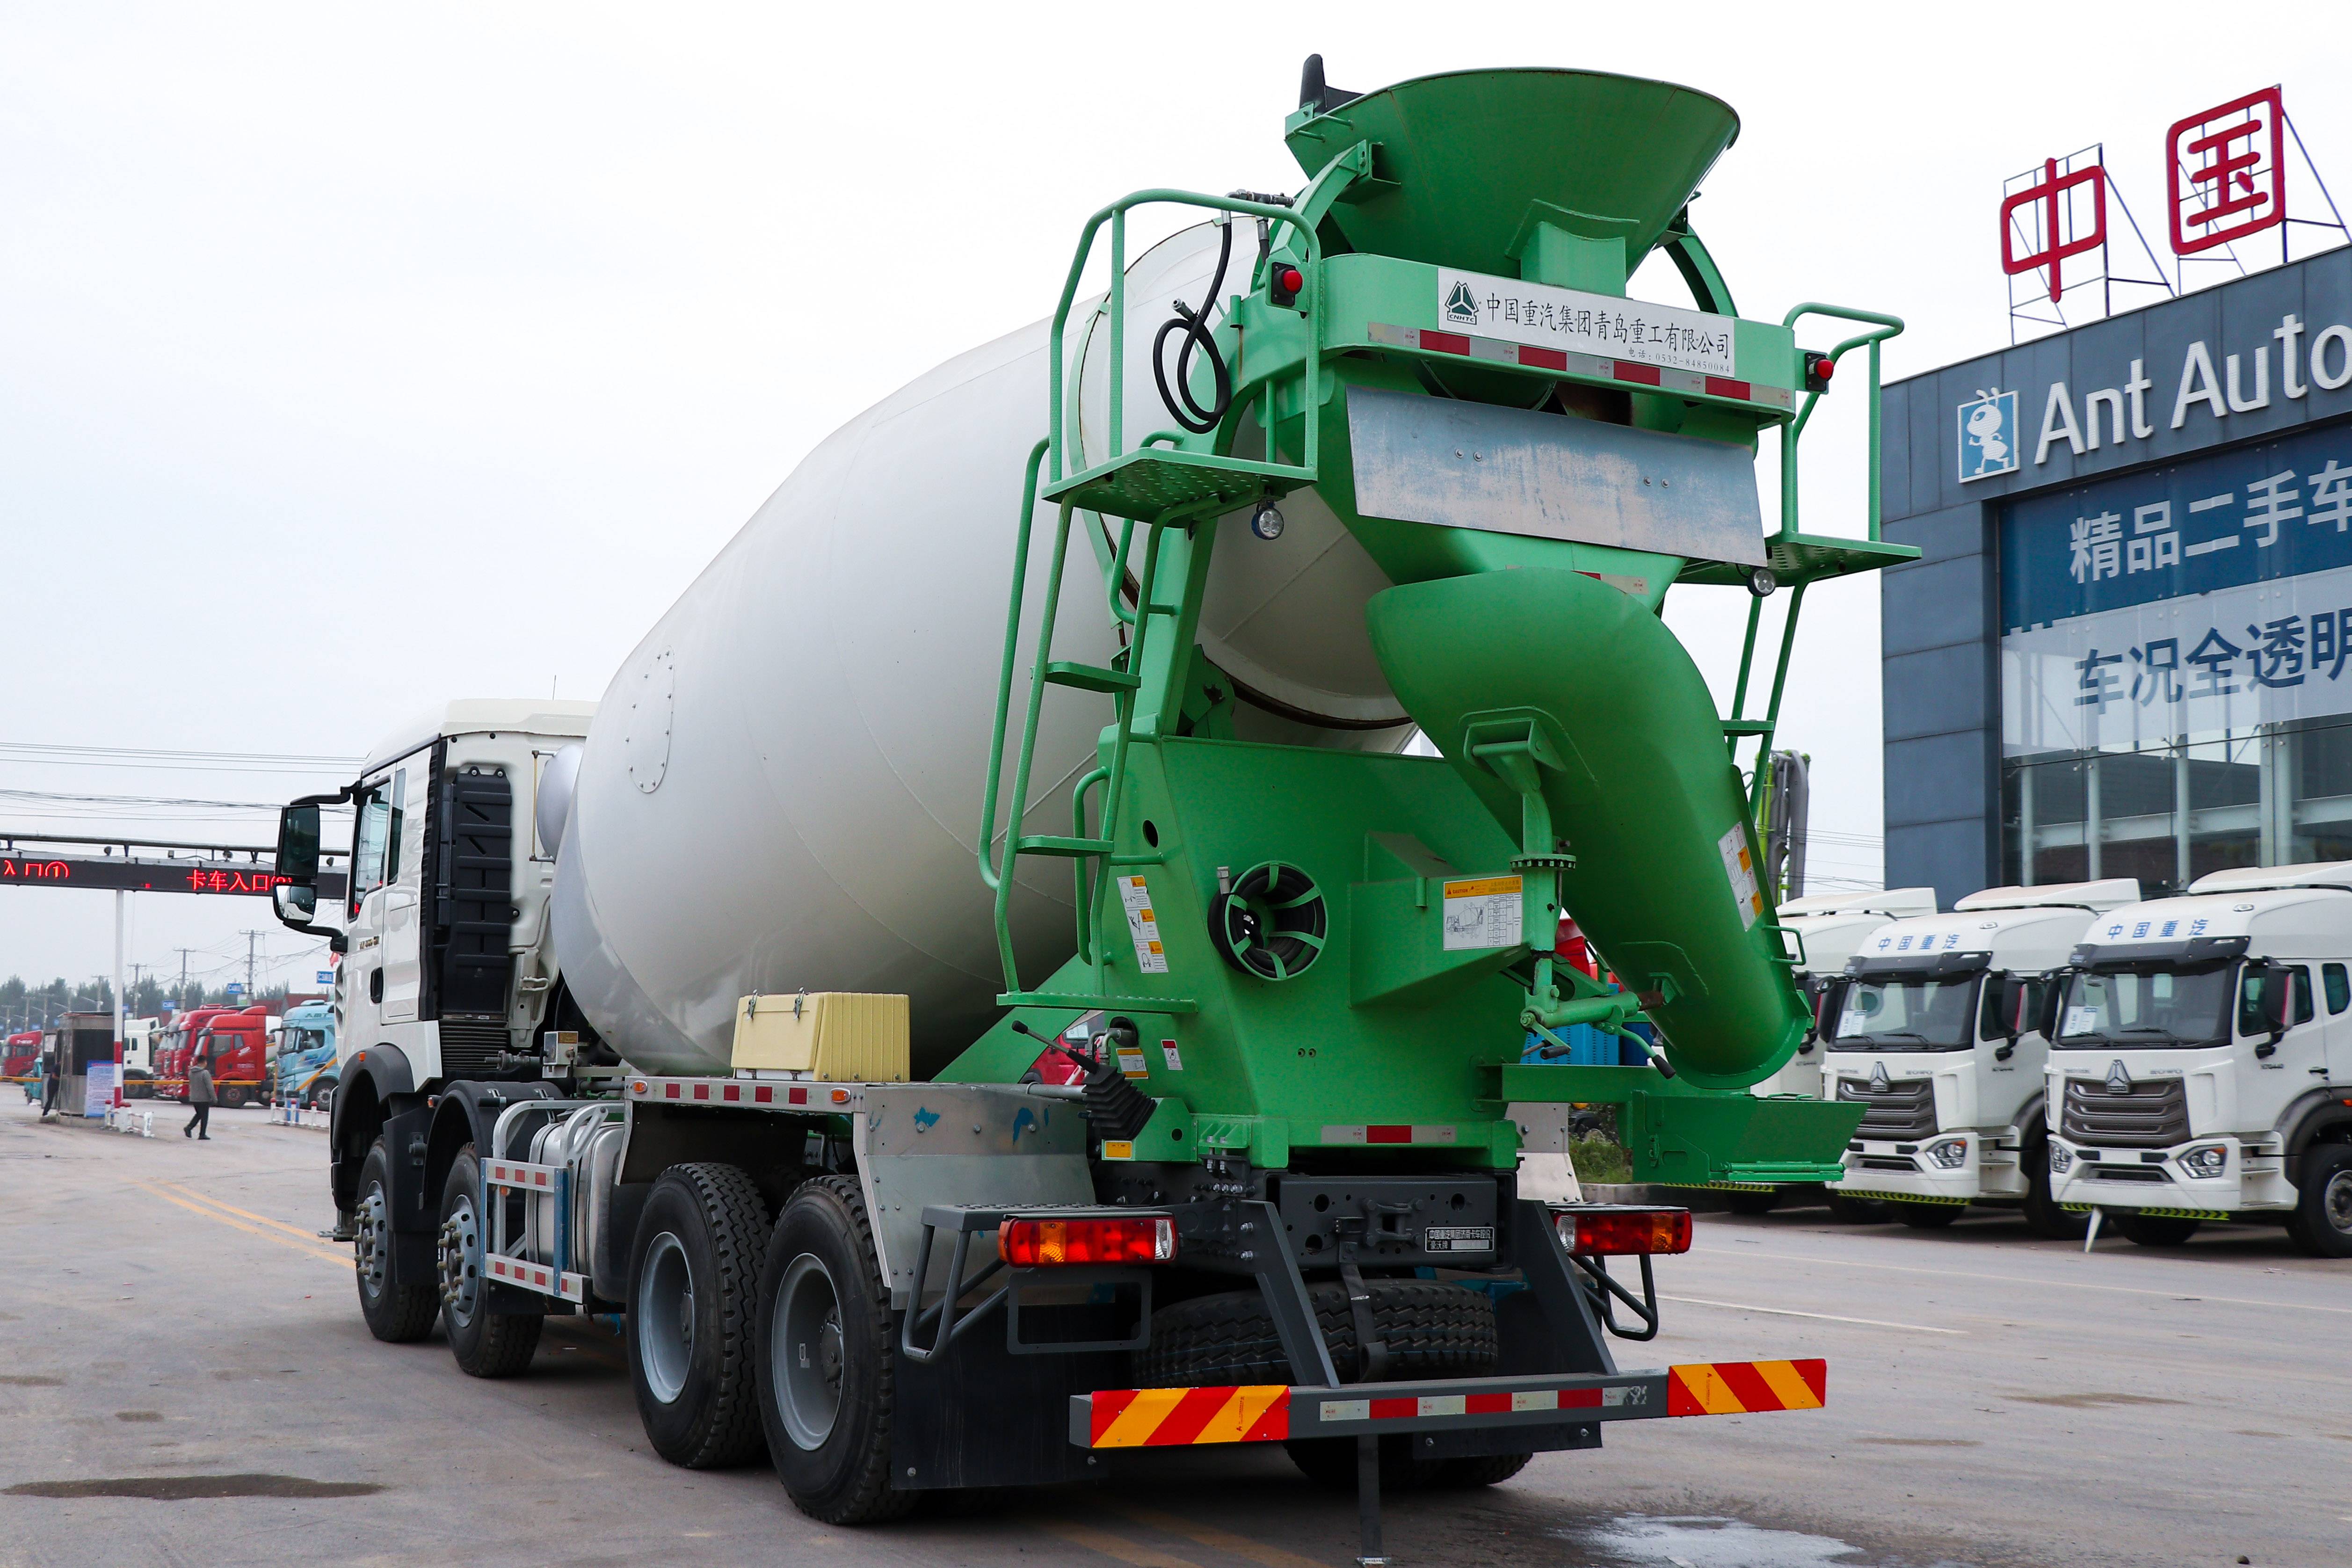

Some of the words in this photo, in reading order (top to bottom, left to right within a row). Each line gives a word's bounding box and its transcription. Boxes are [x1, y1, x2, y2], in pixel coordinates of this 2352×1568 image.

[2000, 87, 2285, 303] 中国
[1449, 314, 1474, 322] CNHTC
[1487, 292, 1728, 360] 中国重汽集团青岛重工有限公司
[2034, 358, 2153, 465] Ant
[2170, 314, 2352, 429] Auto
[2069, 460, 2352, 584] 精品二手车
[2074, 608, 2352, 715] 车况全透明
[1877, 933, 1960, 951] 中国重汽
[2107, 918, 2209, 940] 中国重汽
